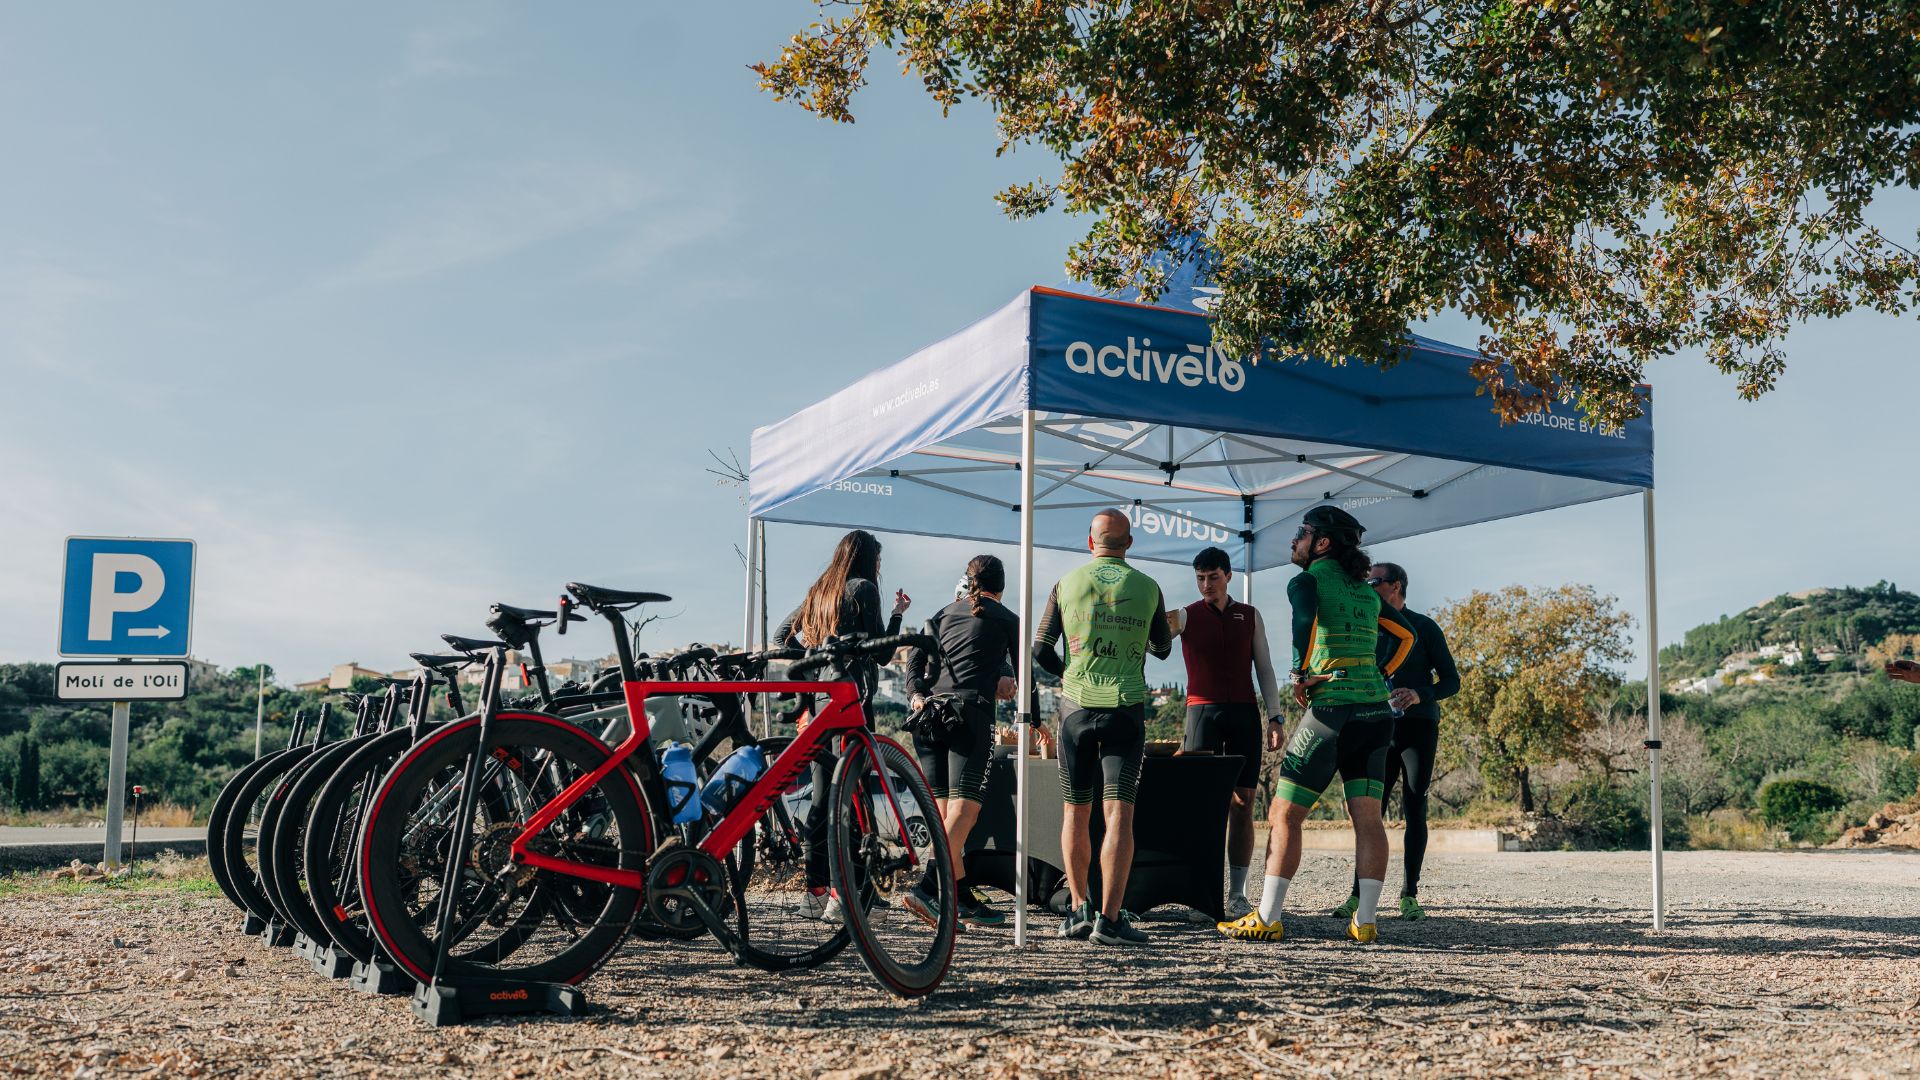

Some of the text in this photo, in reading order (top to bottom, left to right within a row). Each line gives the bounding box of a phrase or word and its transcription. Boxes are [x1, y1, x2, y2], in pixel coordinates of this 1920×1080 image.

[872, 378, 940, 417] www.activelo.es
[88, 553, 166, 641] P
[65, 675, 178, 688] Molí de l'Oli
